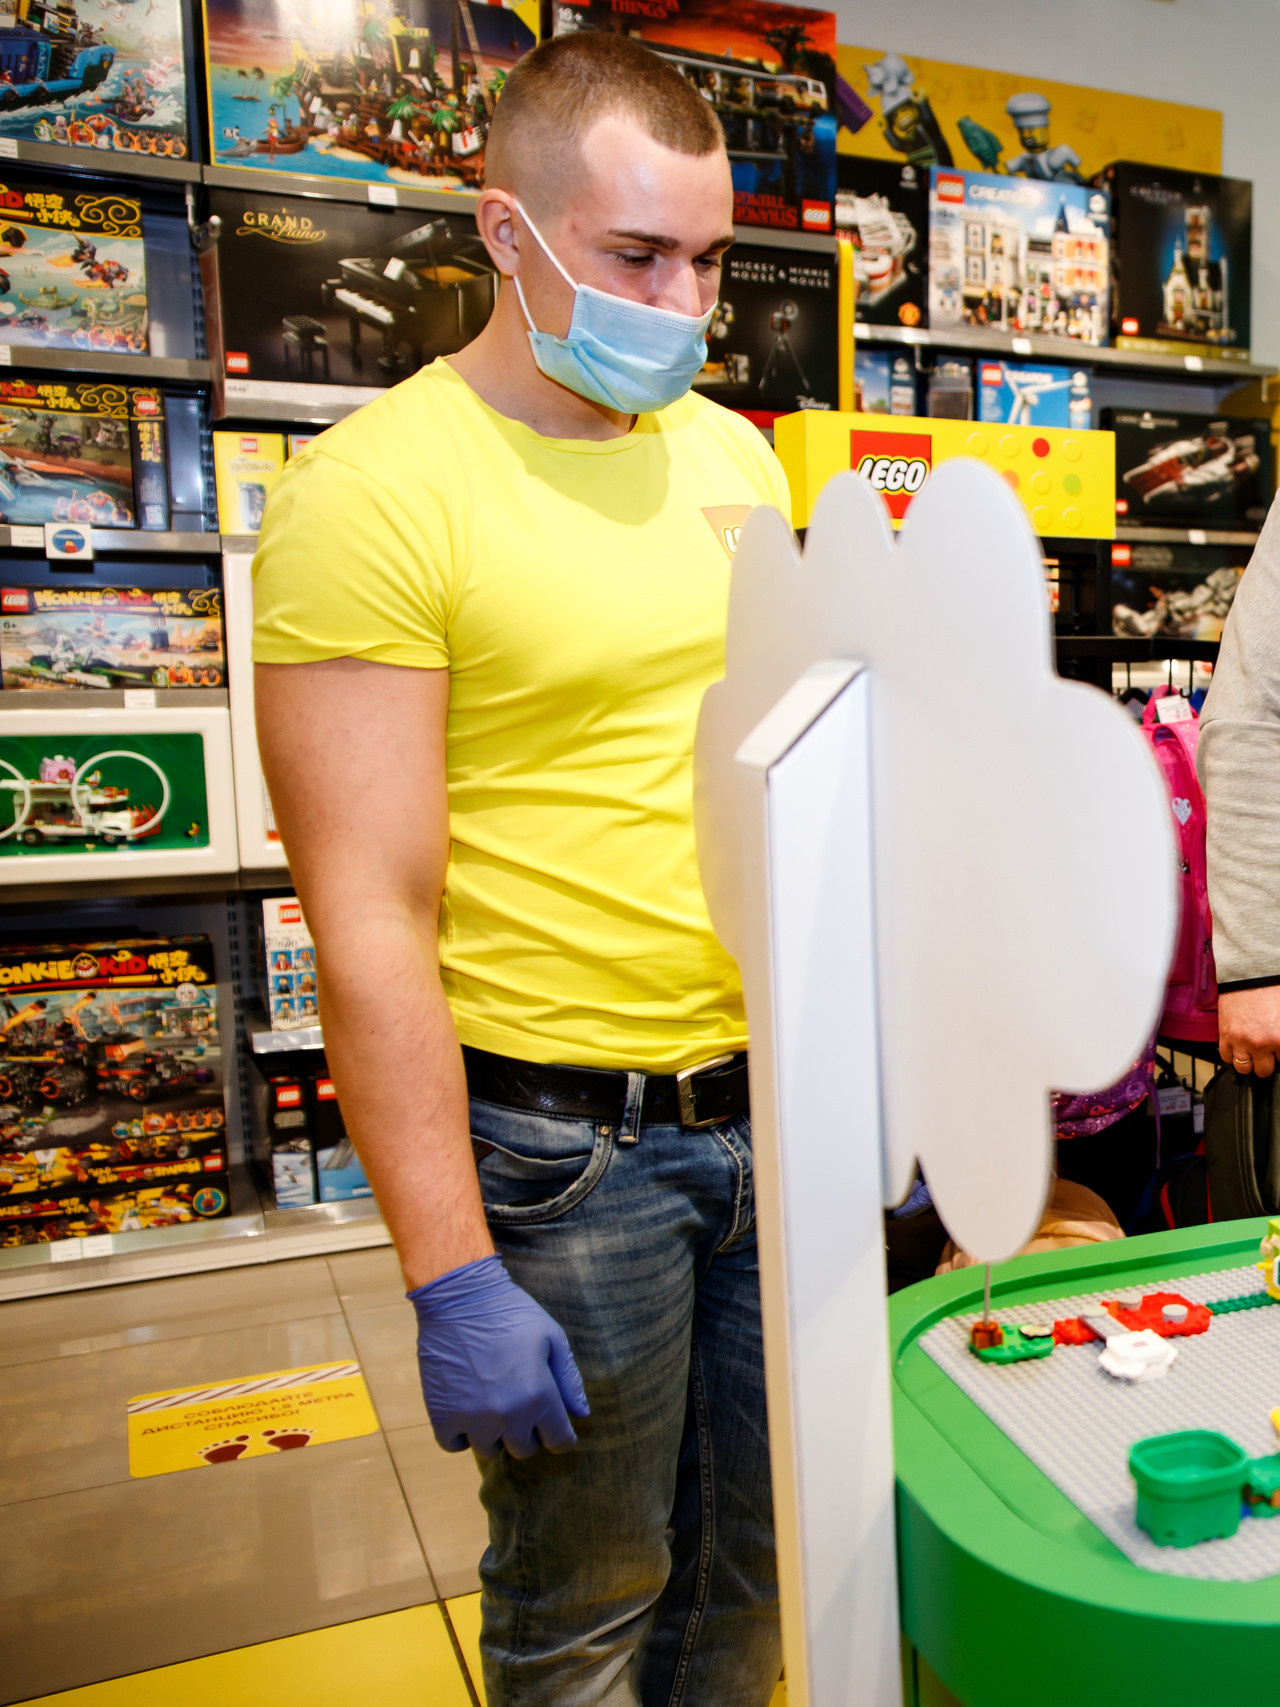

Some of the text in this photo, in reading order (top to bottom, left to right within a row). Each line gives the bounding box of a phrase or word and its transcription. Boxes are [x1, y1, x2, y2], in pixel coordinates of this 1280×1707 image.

[243, 210, 313, 230] GRAND
[731, 260, 775, 272] MICKEY
[789, 266, 830, 278] MINNIE
[731, 270, 830, 288] MOUSE MOUSE
[227, 356, 249, 368] LEGO
[858, 457, 929, 492] LEGO
[3, 594, 27, 606] LEGO
[0, 955, 148, 986] ONKIE KID
[278, 1090, 300, 1102] LEGO
[141, 1407, 263, 1436] ДИСТАНЦИЮ
[298, 1391, 355, 1407] МЕТРА
[183, 1391, 315, 1419] СОБЛЮДАЙТЕ
[203, 1409, 300, 1431] СПАСИБО!
